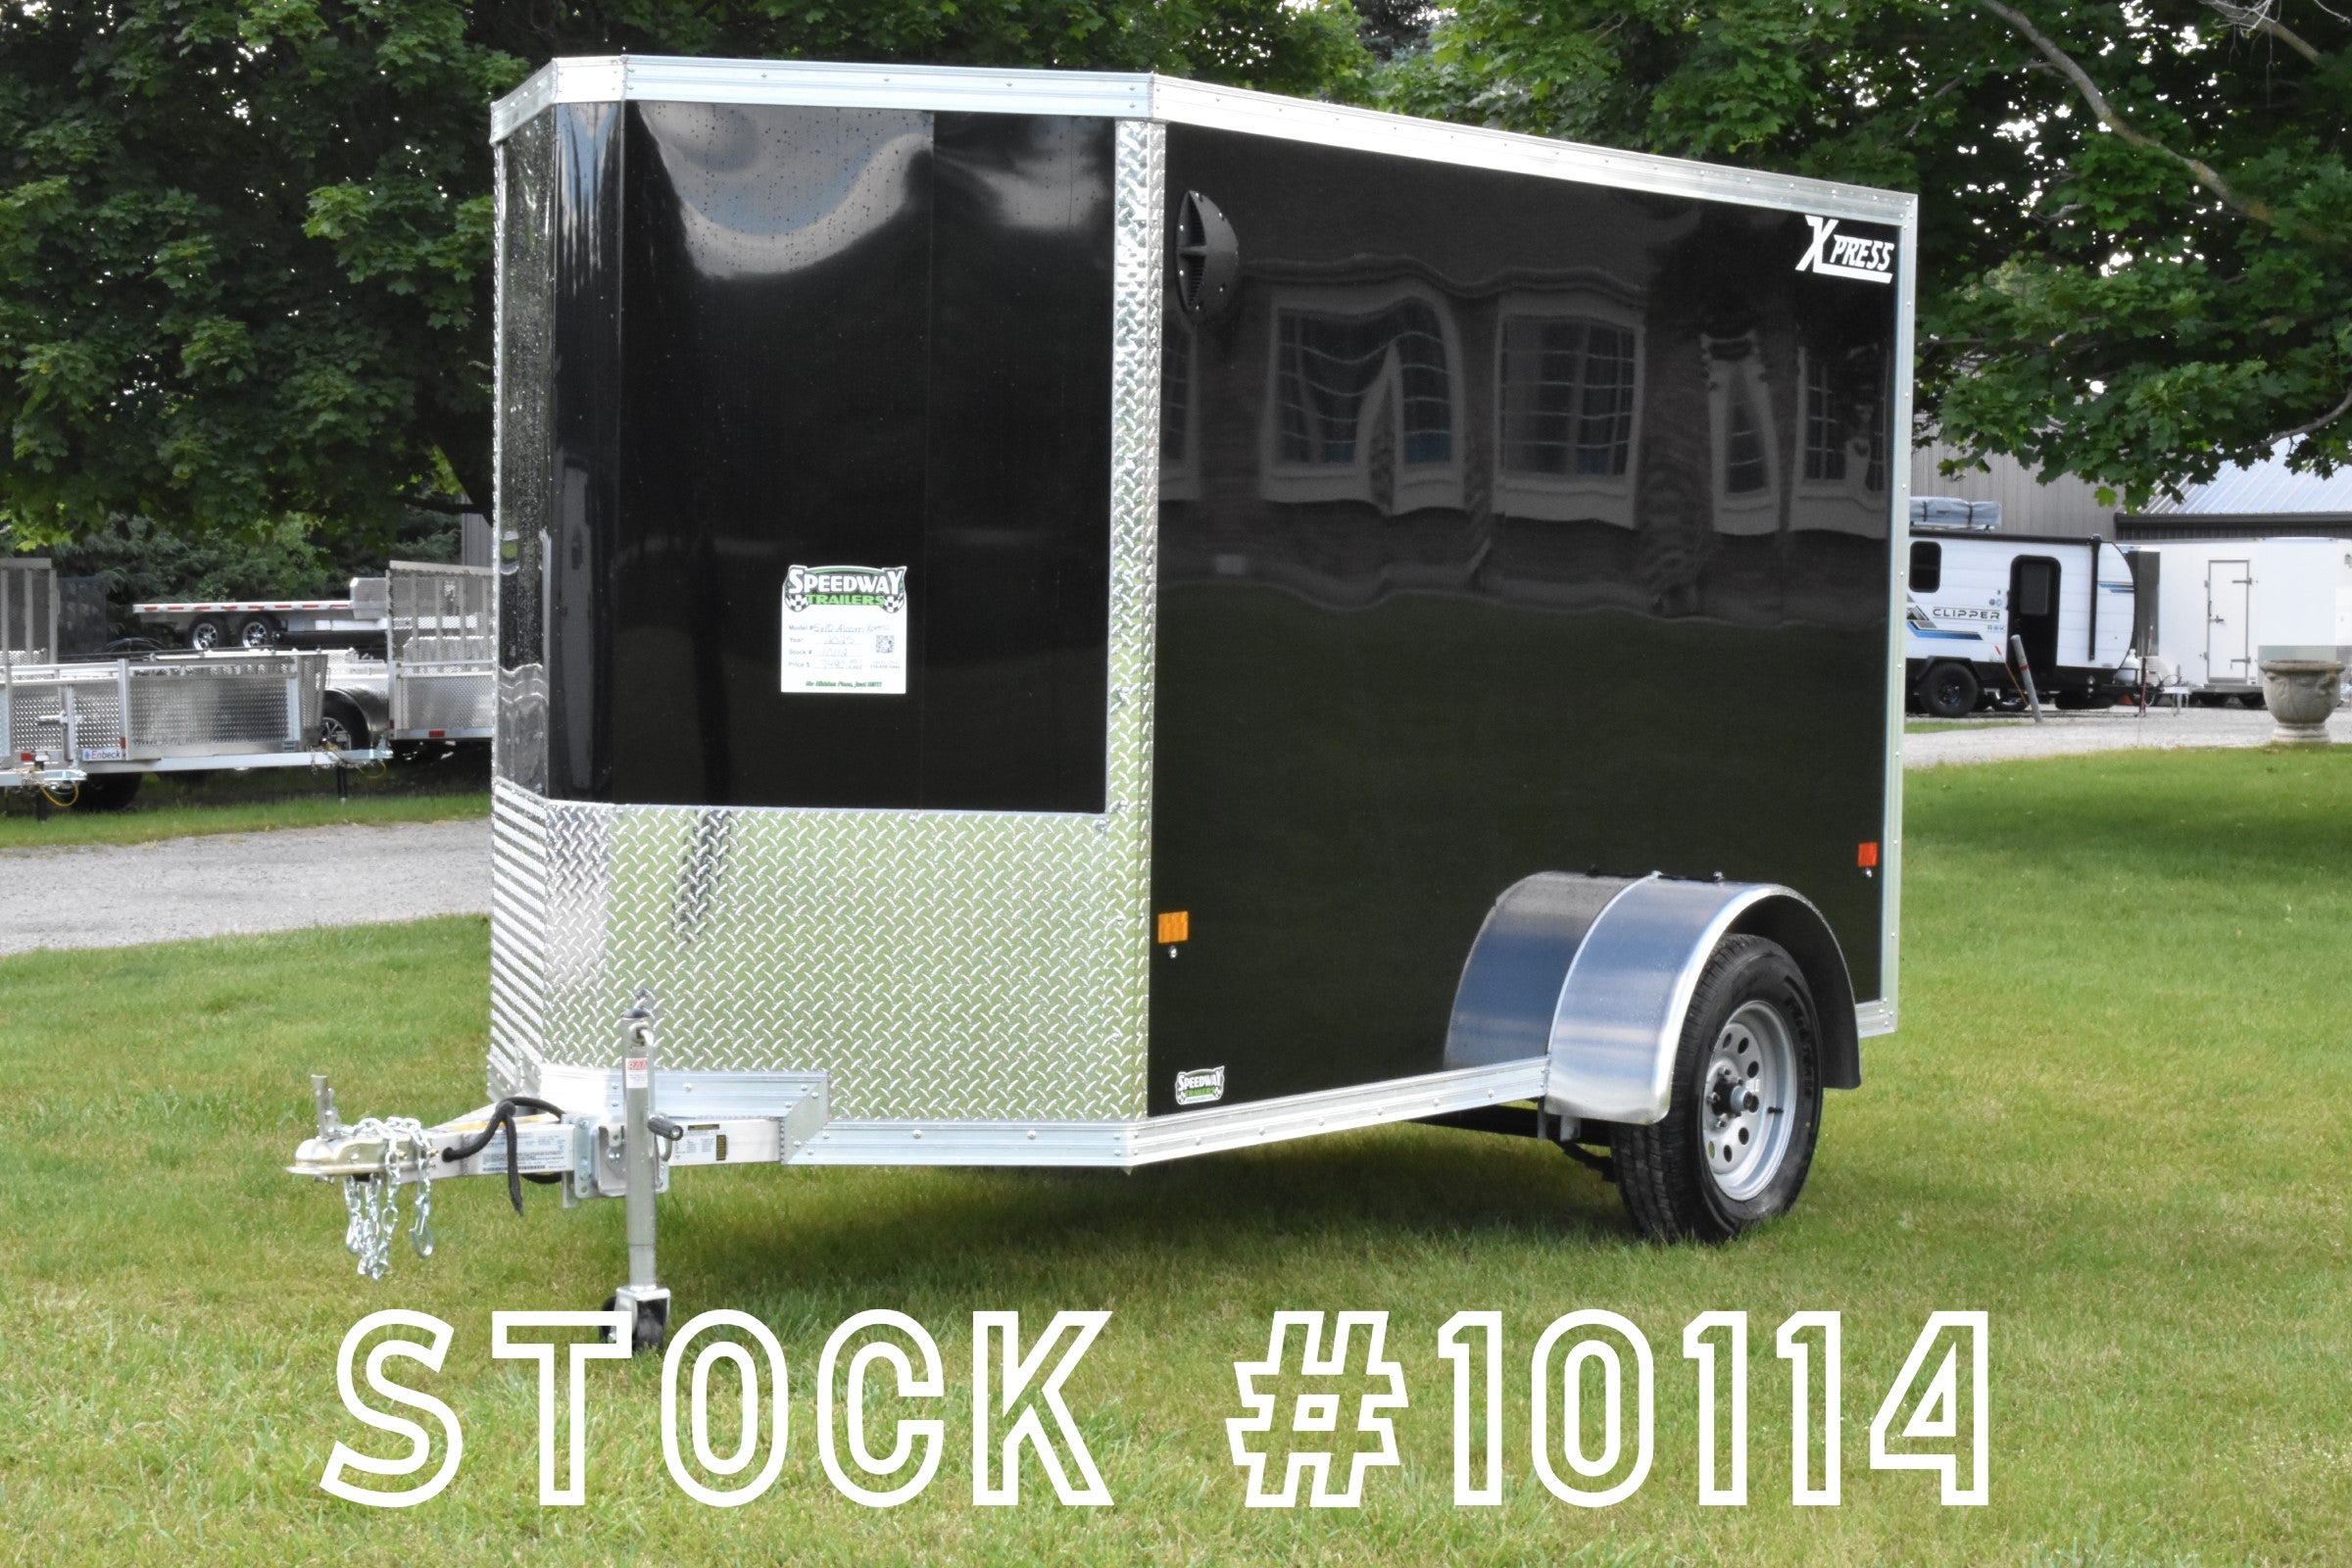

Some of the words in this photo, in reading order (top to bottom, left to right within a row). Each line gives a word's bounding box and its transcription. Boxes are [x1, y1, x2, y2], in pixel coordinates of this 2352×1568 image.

[788, 569, 903, 595] SPEEDWAY
[807, 594, 886, 606] TRAILERS
[1933, 609, 2000, 619] CLIPPER
[1178, 1070, 1222, 1092] SPEEDWAY
